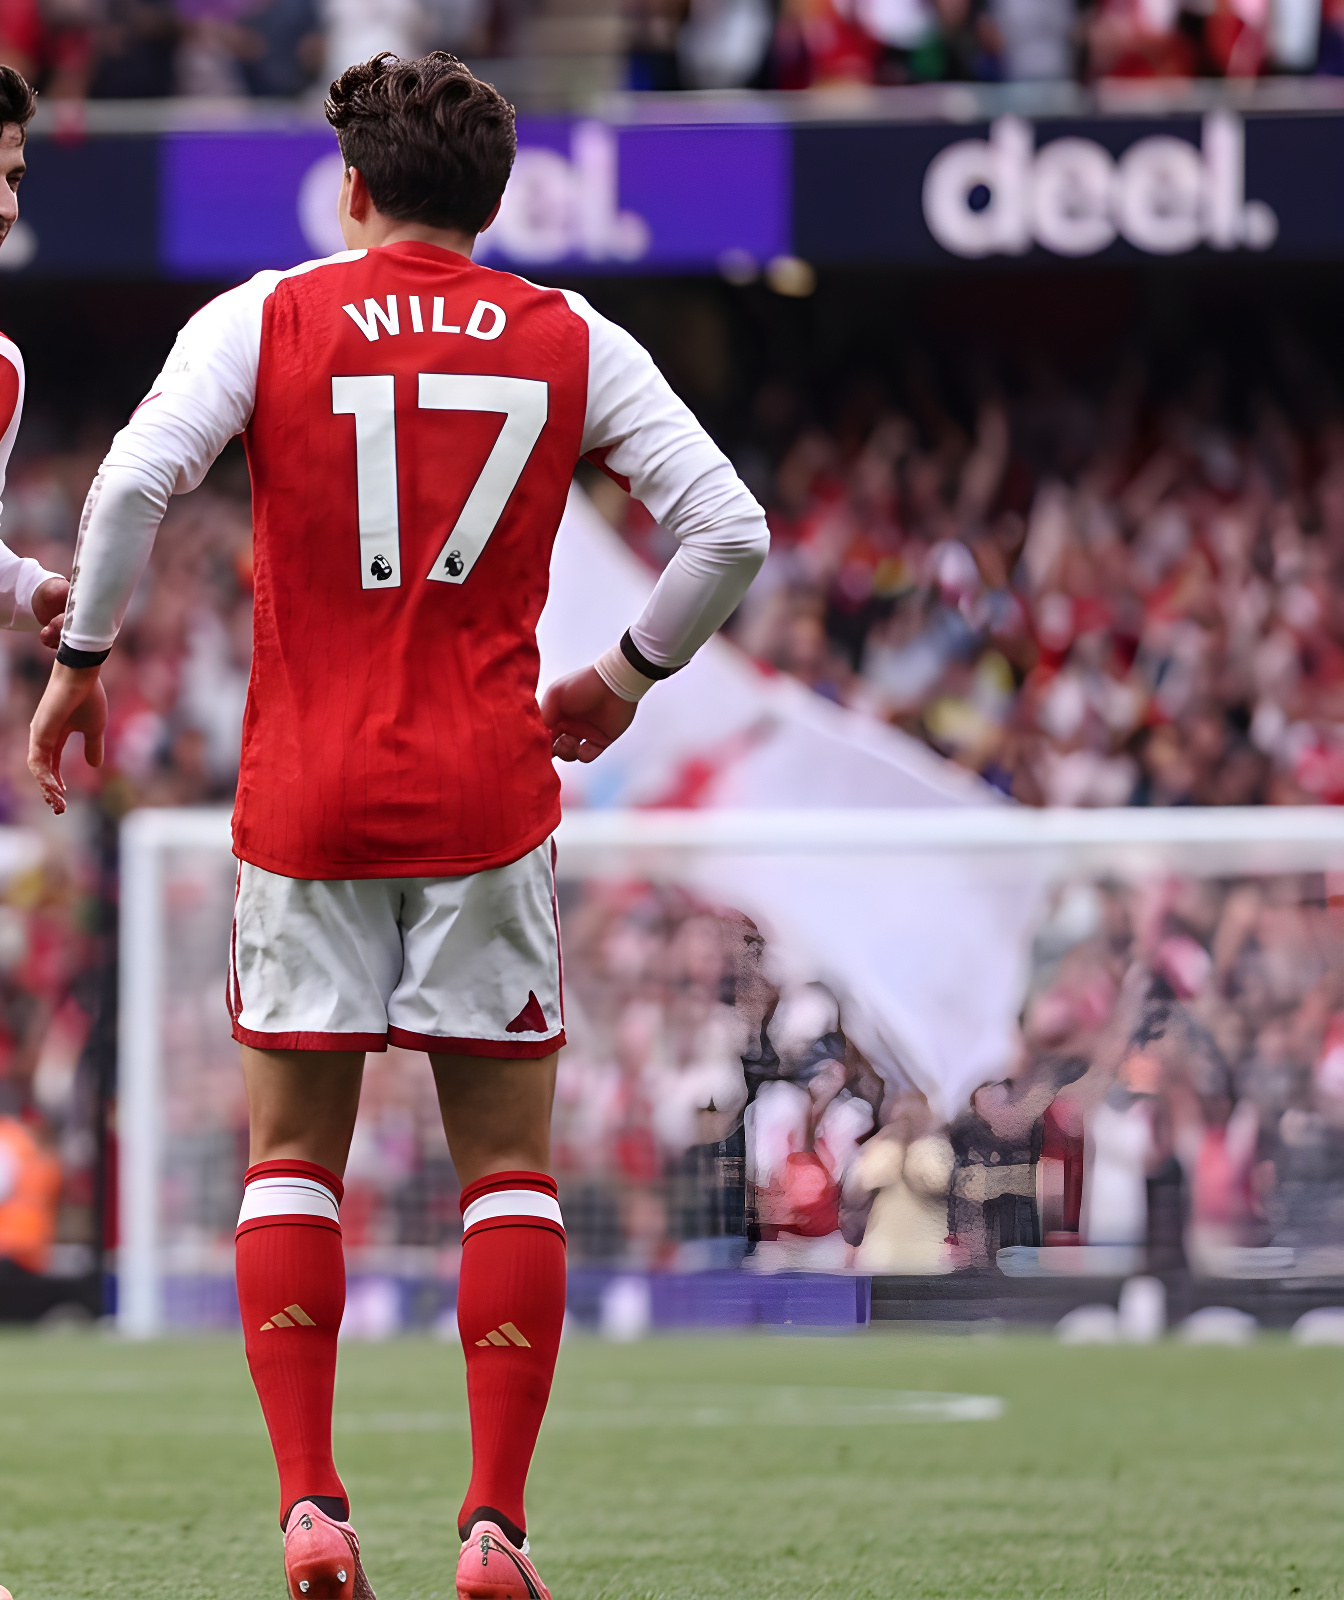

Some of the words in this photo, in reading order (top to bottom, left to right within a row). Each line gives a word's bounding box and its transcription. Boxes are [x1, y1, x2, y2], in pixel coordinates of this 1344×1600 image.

[921, 110, 1280, 260] deel.
[342, 294, 506, 342] WILD
[331, 372, 549, 590] 17
